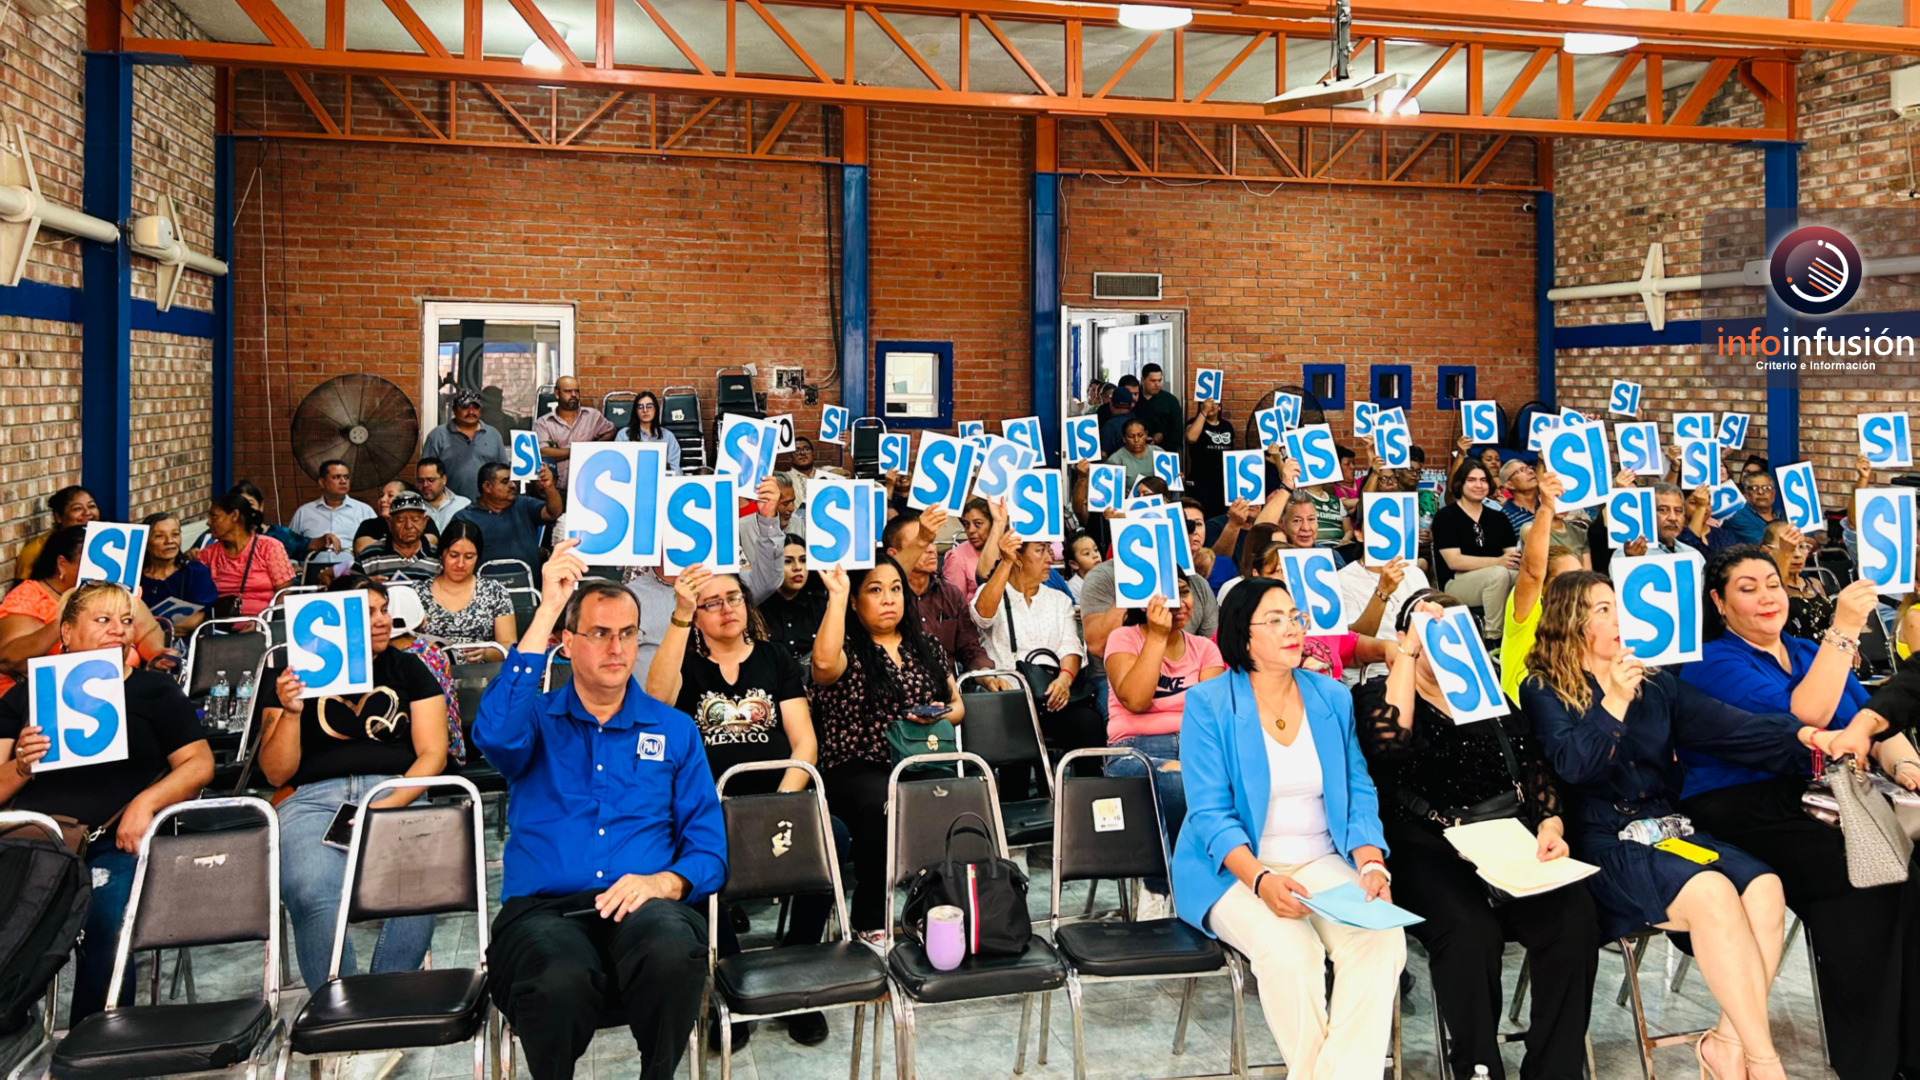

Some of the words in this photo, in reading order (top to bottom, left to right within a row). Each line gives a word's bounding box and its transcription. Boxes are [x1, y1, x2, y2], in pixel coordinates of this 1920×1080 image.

[1196, 370, 1221, 401] SI
[1275, 394, 1300, 427] SI
[1611, 383, 1639, 414] SI
[822, 407, 847, 441] SI
[1259, 408, 1285, 446] SI
[1620, 425, 1659, 470] SI
[1718, 415, 1748, 447] SI
[1862, 415, 1909, 462] SI
[513, 433, 541, 476] SI
[717, 421, 777, 489] SI
[879, 435, 908, 472] SI
[911, 439, 974, 511] SI
[1155, 453, 1182, 488] SI
[1548, 426, 1609, 504] SI
[1684, 441, 1718, 487] SI
[569, 449, 660, 556] SI
[1011, 473, 1061, 536] SI
[1090, 466, 1124, 510] SI
[1784, 466, 1821, 529] SI
[666, 480, 734, 568] SI
[809, 485, 870, 563] SI
[1367, 496, 1416, 561] SI
[1610, 491, 1654, 544] SI
[1862, 494, 1913, 587] SI
[81, 527, 145, 592] SI
[1117, 523, 1175, 601] SI
[1621, 559, 1697, 659] SI
[292, 596, 367, 689] SI
[1425, 612, 1503, 713] SI
[643, 740, 662, 753] PAN
[704, 732, 769, 746] MEXICO
